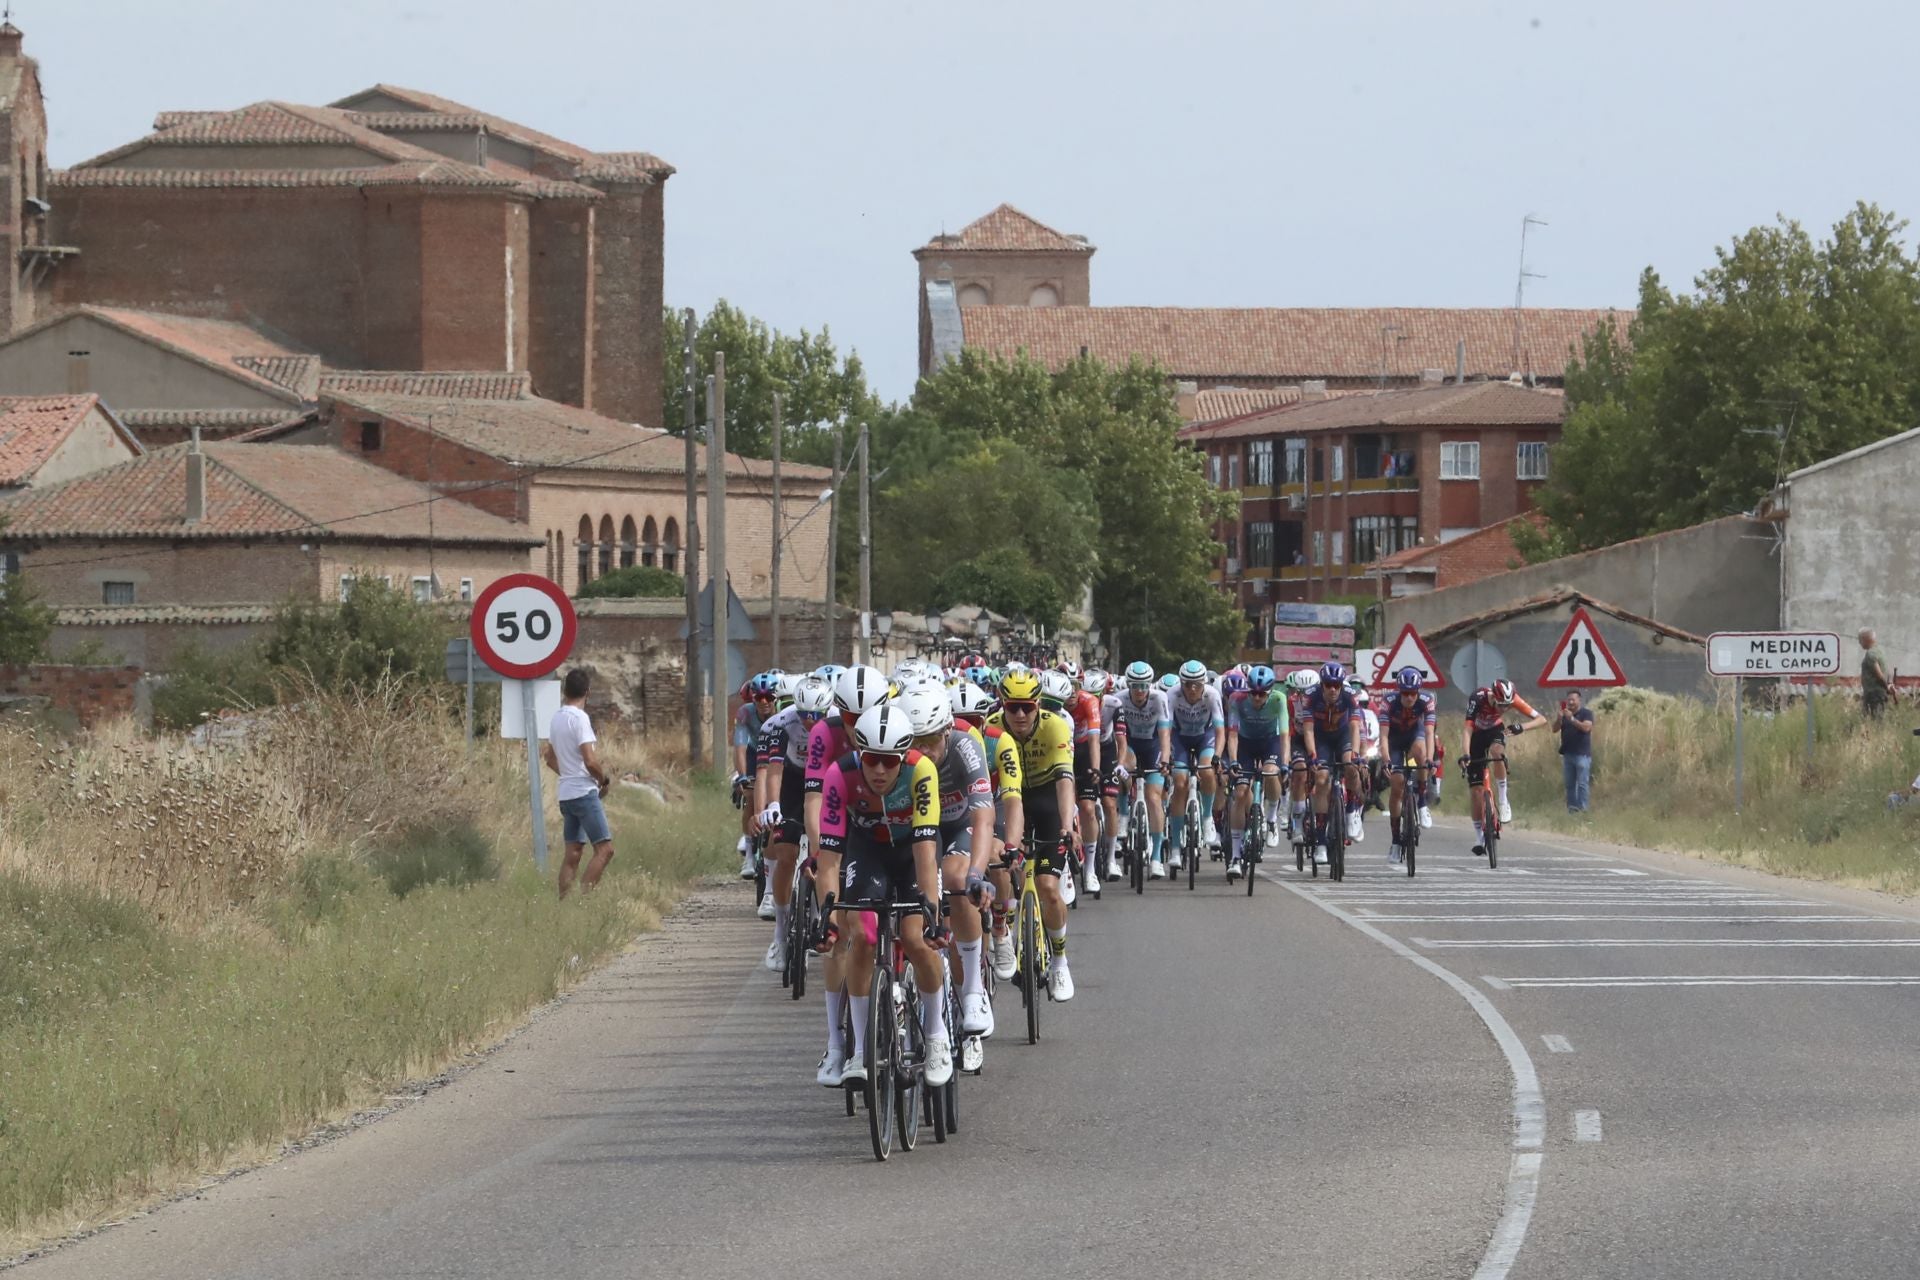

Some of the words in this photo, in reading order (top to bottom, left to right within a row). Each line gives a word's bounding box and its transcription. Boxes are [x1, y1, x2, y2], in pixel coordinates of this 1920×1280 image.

[496, 609, 551, 643] 50
[1750, 640, 1826, 653] MEDINA
[1746, 658, 1773, 669] DEL
[1781, 658, 1831, 669] CAMPO
[956, 737, 983, 771] Alpecin
